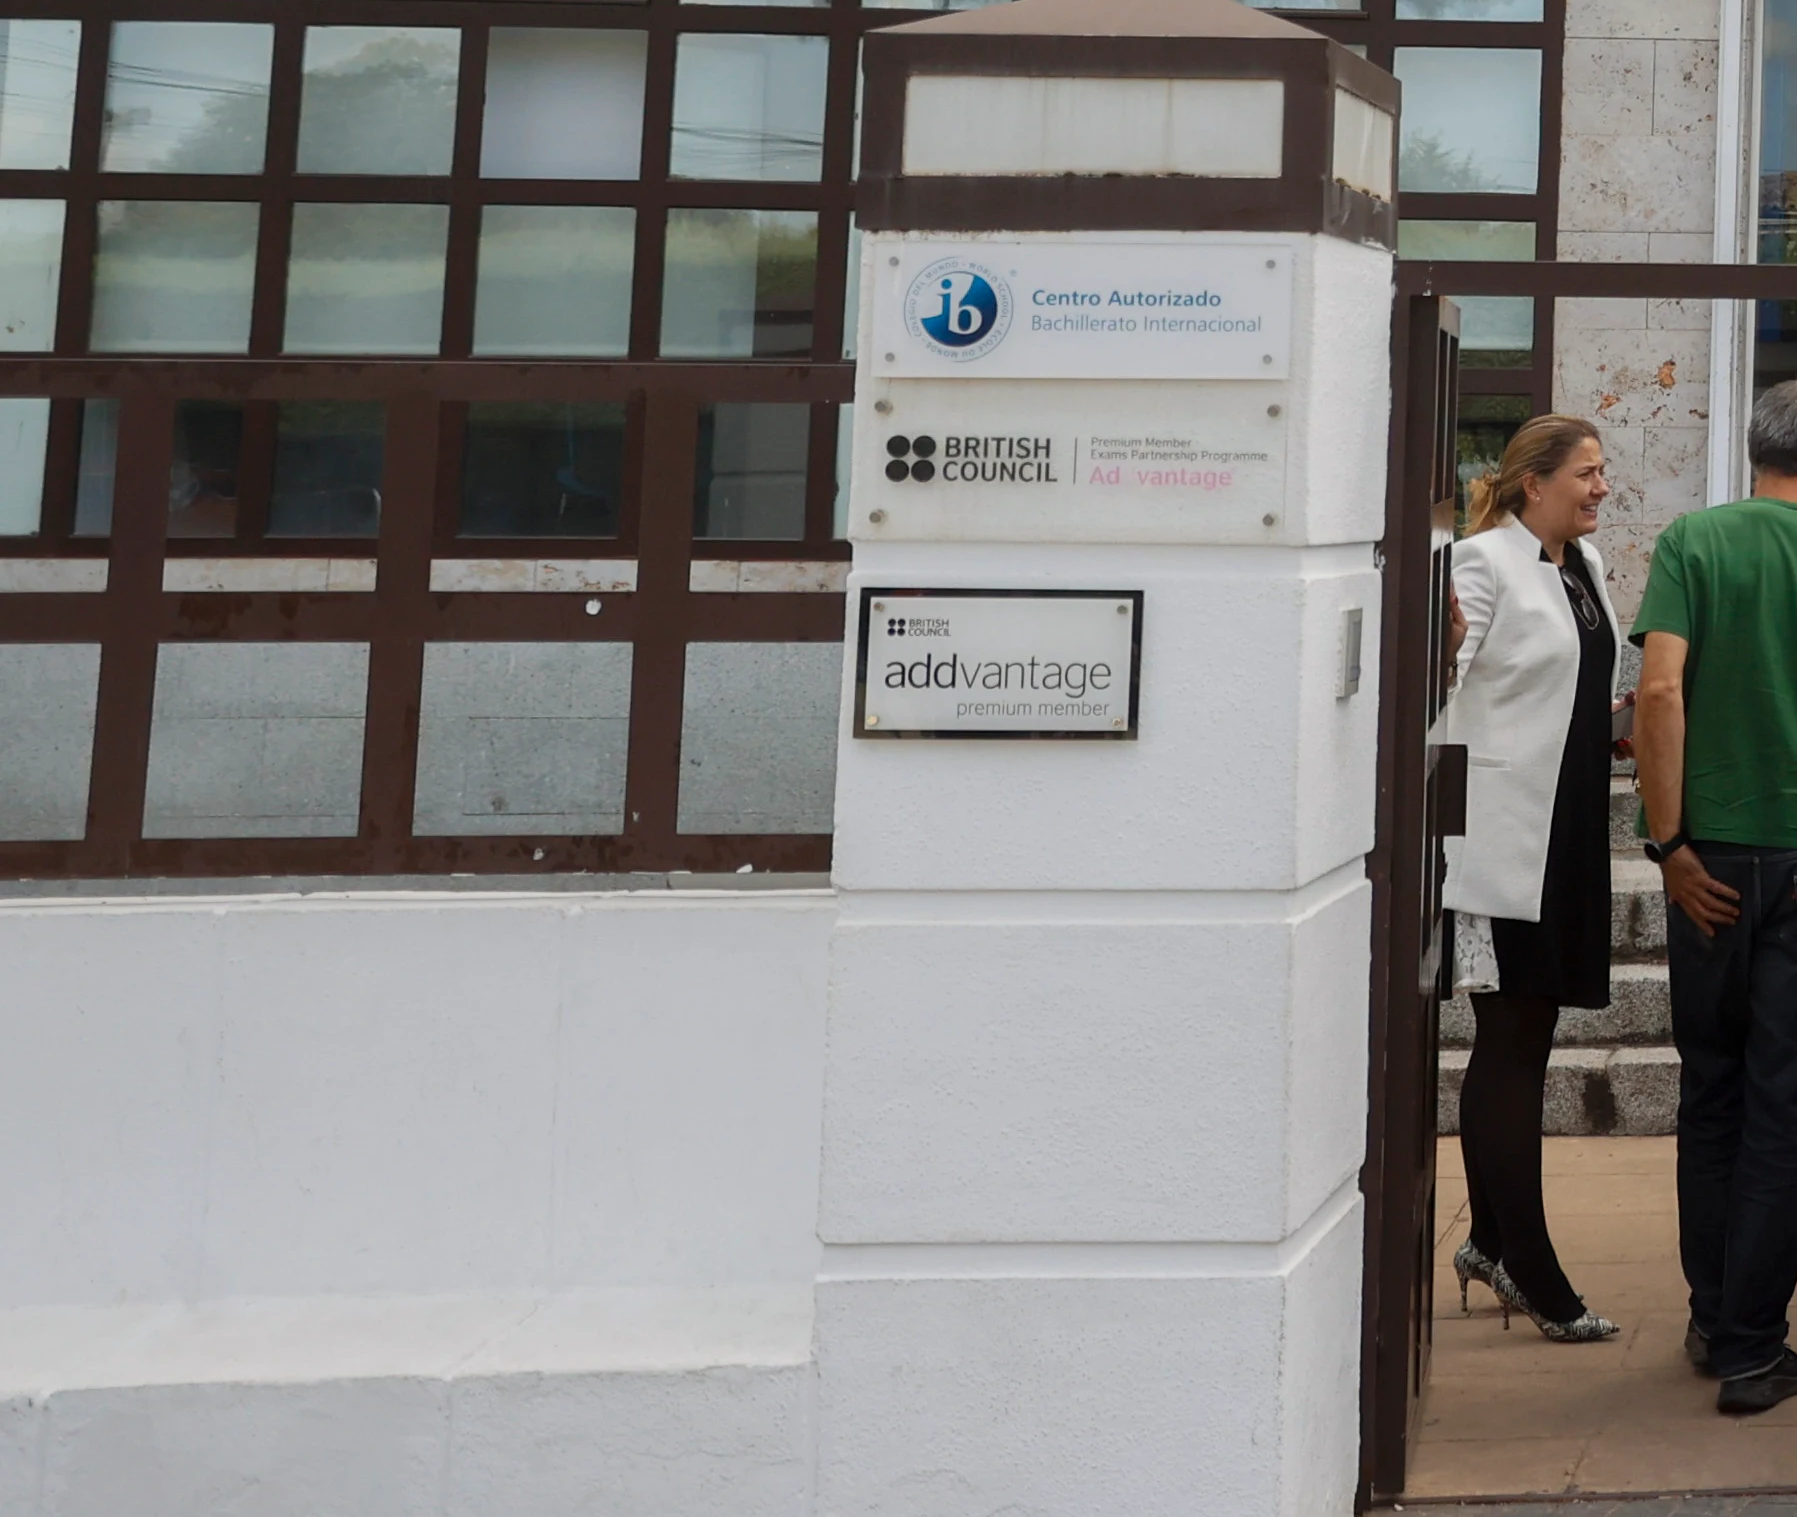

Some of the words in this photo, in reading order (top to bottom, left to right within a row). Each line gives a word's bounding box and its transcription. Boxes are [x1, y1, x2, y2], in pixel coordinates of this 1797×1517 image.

[1031, 289, 1101, 308] Centro
[1107, 289, 1223, 309] Autorizado
[1031, 314, 1138, 333] Bachillerato
[1143, 315, 1262, 334] Internacional
[944, 436, 1052, 460] BRITISH
[1090, 436, 1142, 448] Premium
[1145, 437, 1192, 448] Member
[1090, 449, 1128, 460] Exams
[1130, 450, 1198, 463] Partnership
[1200, 450, 1269, 464] Programme
[942, 460, 1058, 483] COUNCIL
[907, 627, 951, 637] COUNCIL
[908, 618, 950, 629] BRITISH
[884, 653, 1112, 699] addvantage
[956, 700, 1033, 719] premium
[1038, 699, 1110, 717] member
